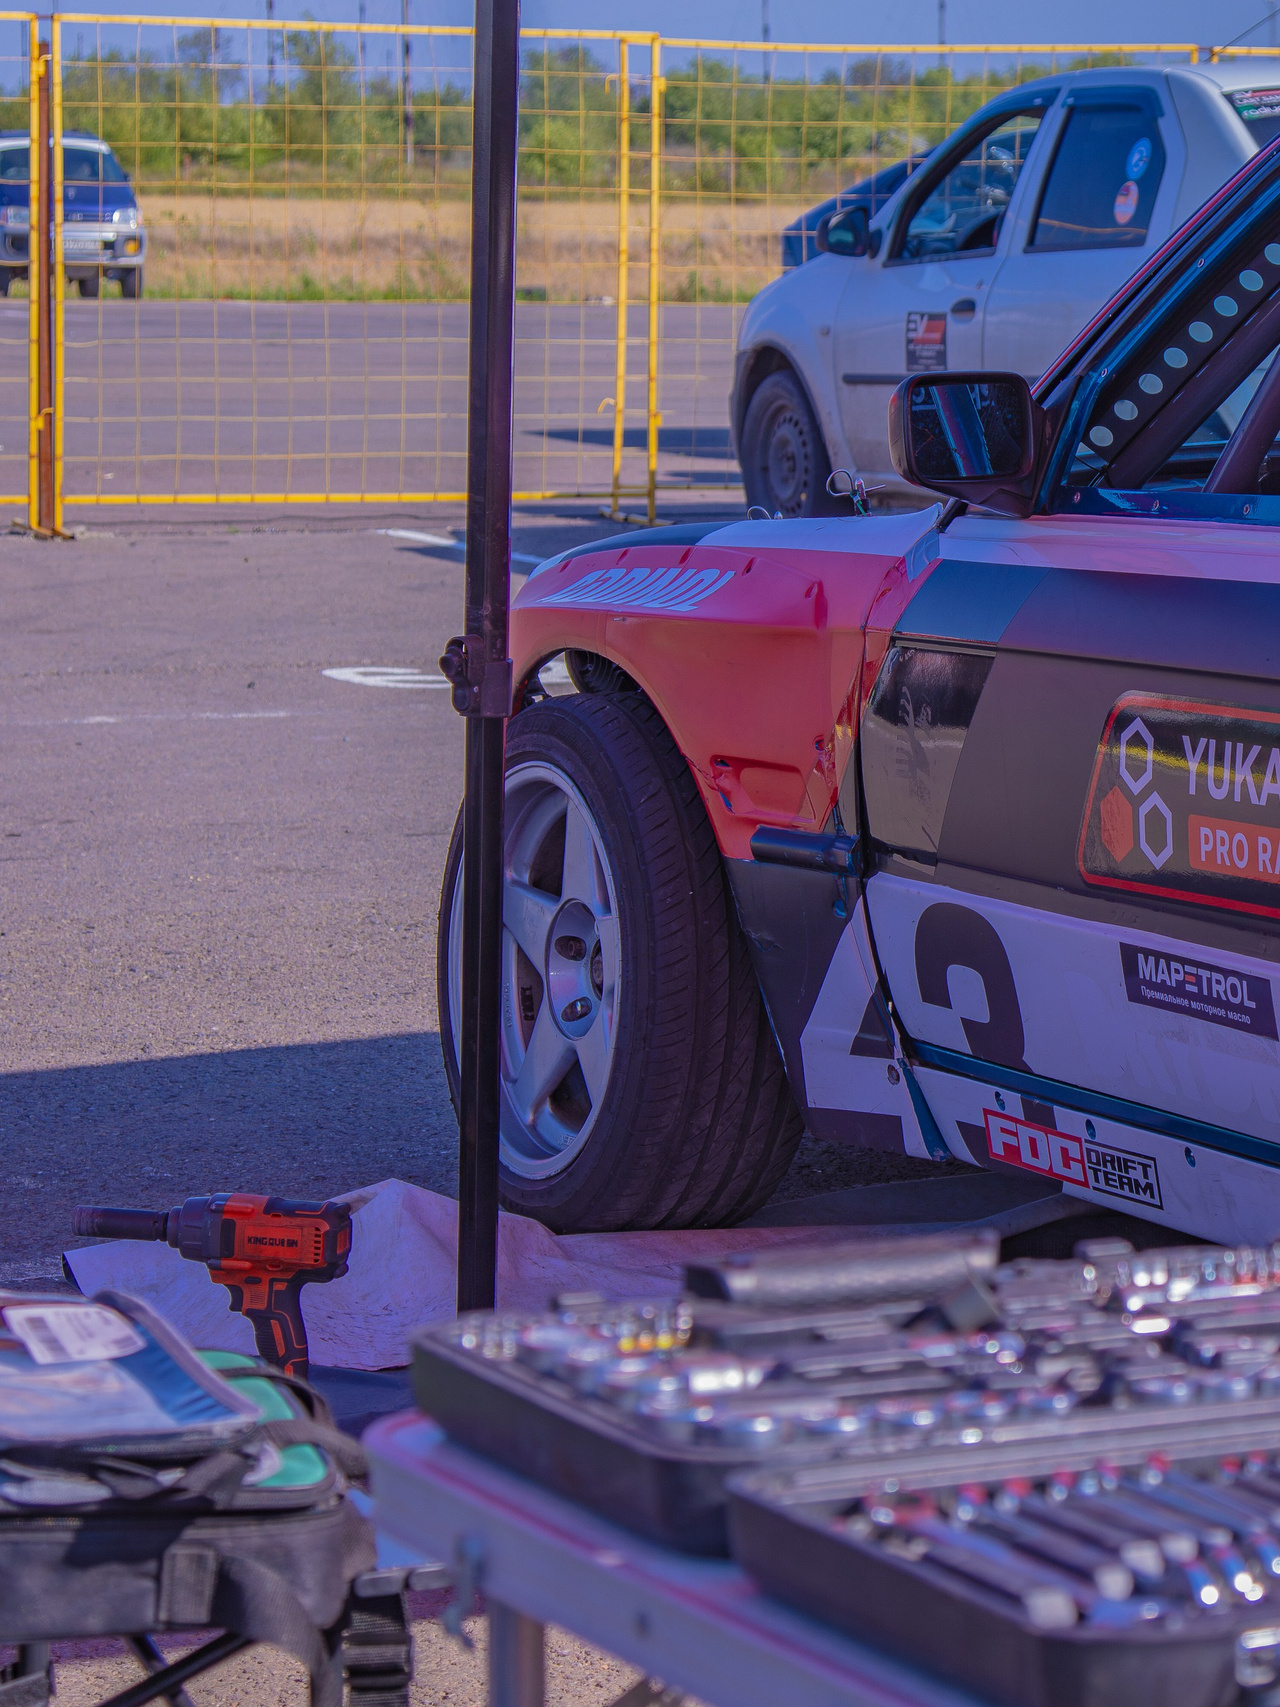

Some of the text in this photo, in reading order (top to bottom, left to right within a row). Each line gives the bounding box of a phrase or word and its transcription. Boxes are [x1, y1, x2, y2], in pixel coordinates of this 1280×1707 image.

[1199, 826, 1249, 870] PRO
[1137, 953, 1257, 1009] MAPETROL
[1140, 985, 1251, 1025] Премиальное моторное масло
[986, 1114, 1086, 1183] FDC
[1085, 1147, 1152, 1181] DRIFT
[1087, 1166, 1156, 1200] TEAM
